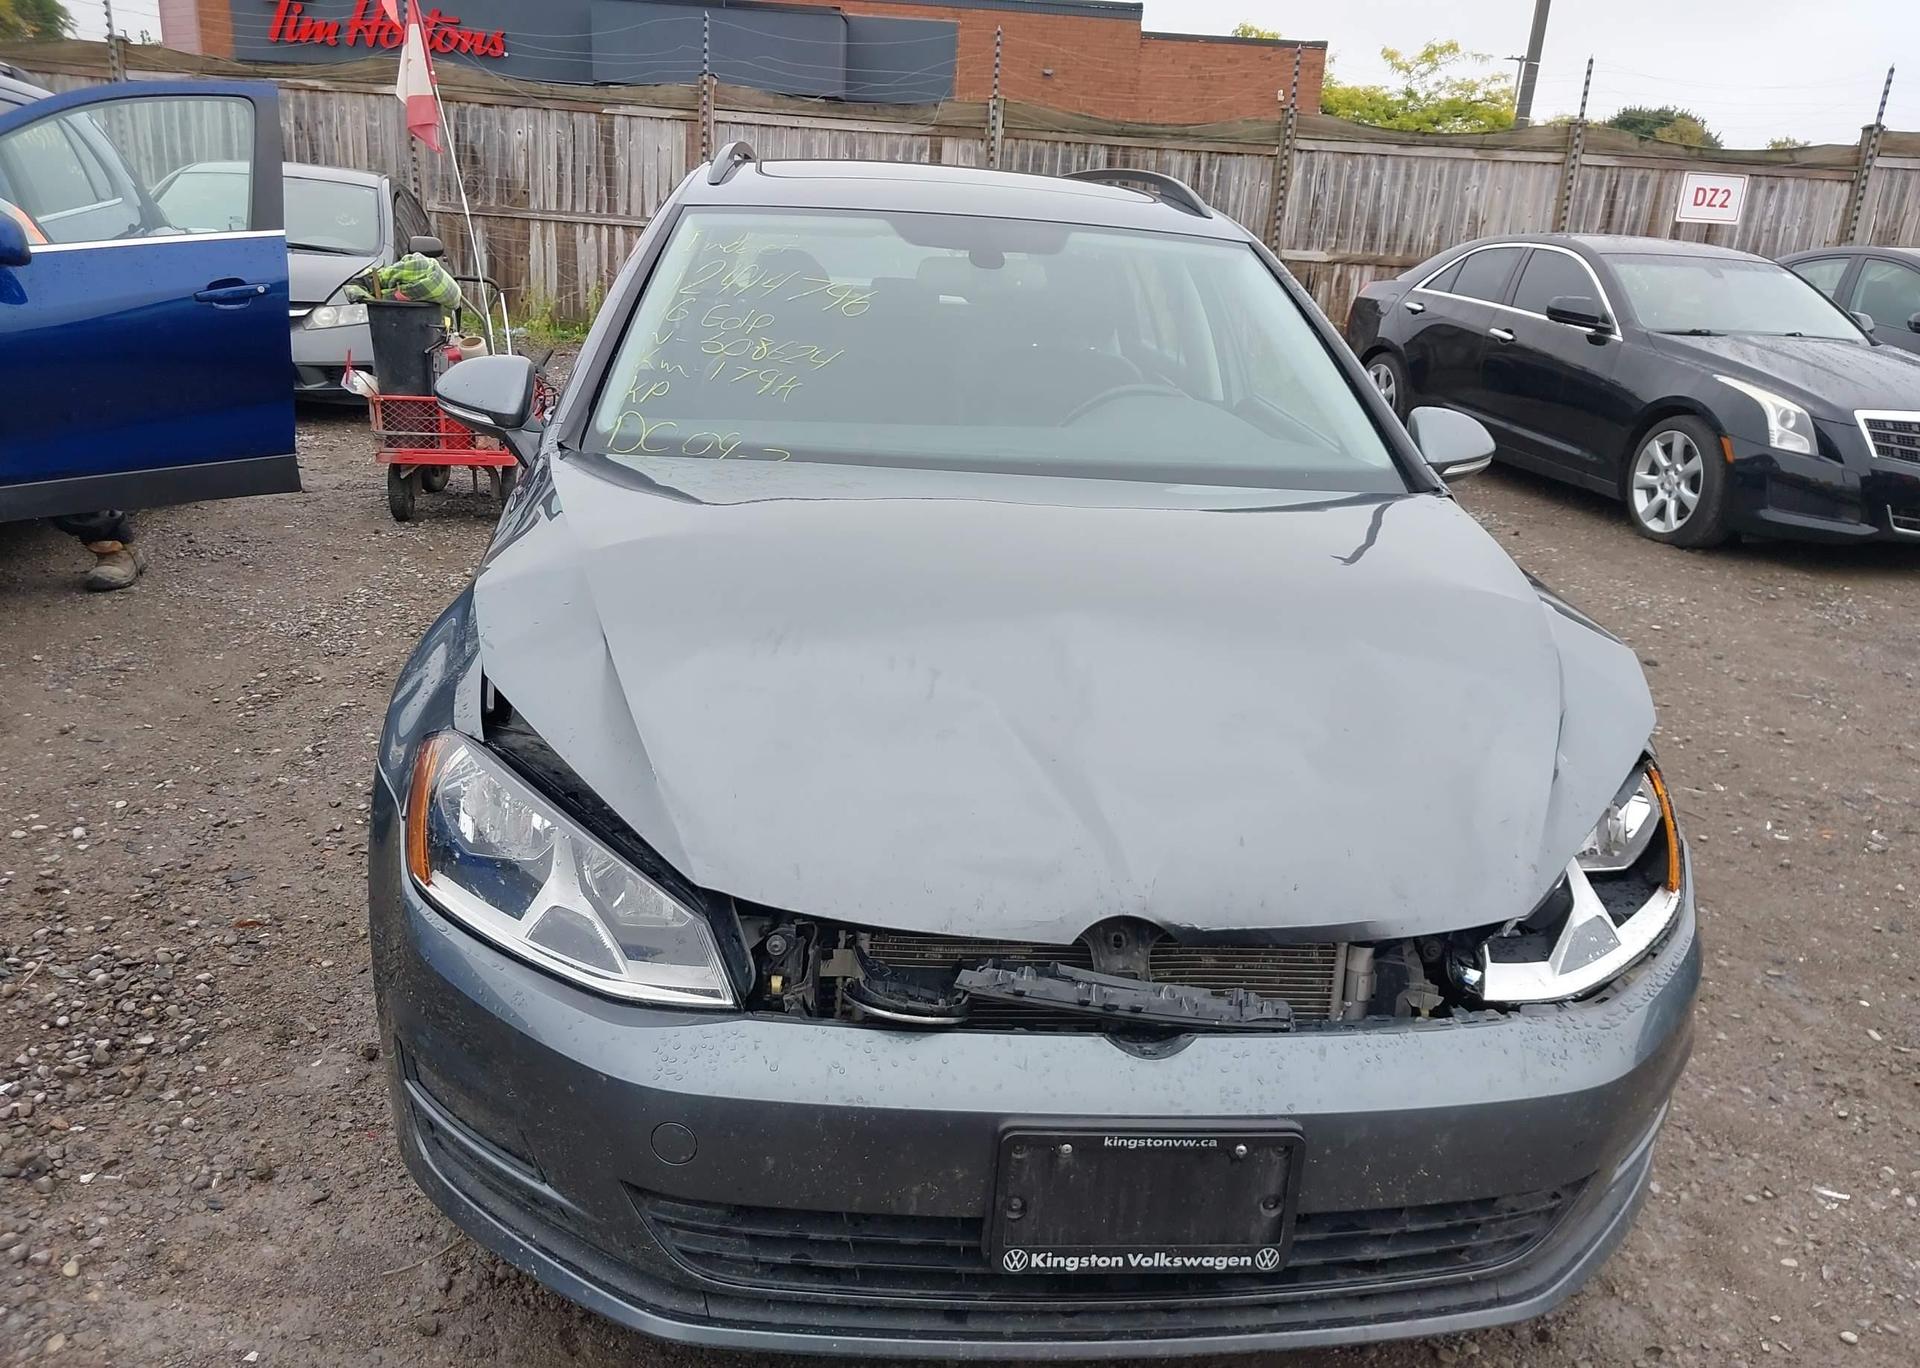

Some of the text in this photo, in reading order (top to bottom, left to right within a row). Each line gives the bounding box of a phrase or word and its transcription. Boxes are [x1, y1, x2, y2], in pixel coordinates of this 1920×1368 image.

[268, 0, 506, 57] Tim Hotons
[1693, 186, 1732, 208] DZ2
[1103, 1136, 1218, 1148] kingstonvw.ca
[1030, 1253, 1123, 1271] Kingston
[1127, 1252, 1252, 1270] Volkswagen
